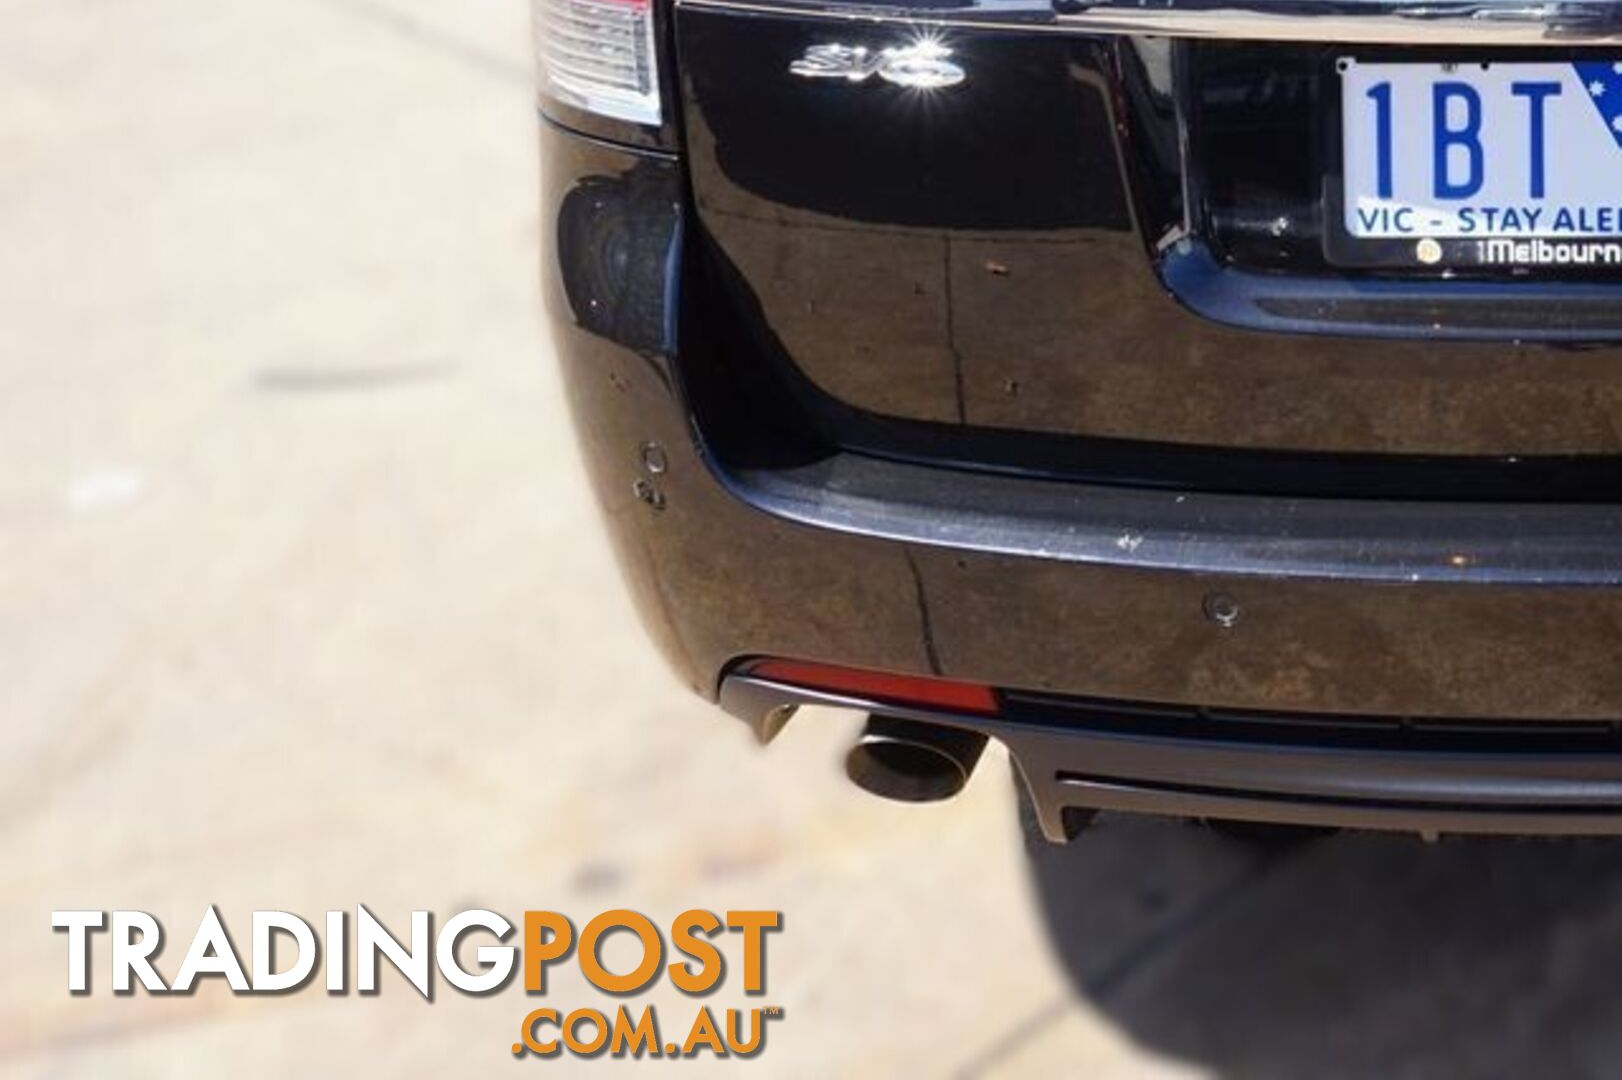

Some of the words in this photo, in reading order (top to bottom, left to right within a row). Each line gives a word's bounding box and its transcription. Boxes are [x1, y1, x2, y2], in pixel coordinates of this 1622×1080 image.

[1366, 80, 1563, 200] 1BT
[1358, 207, 1414, 233] VIC
[1458, 206, 1543, 233] STAY
